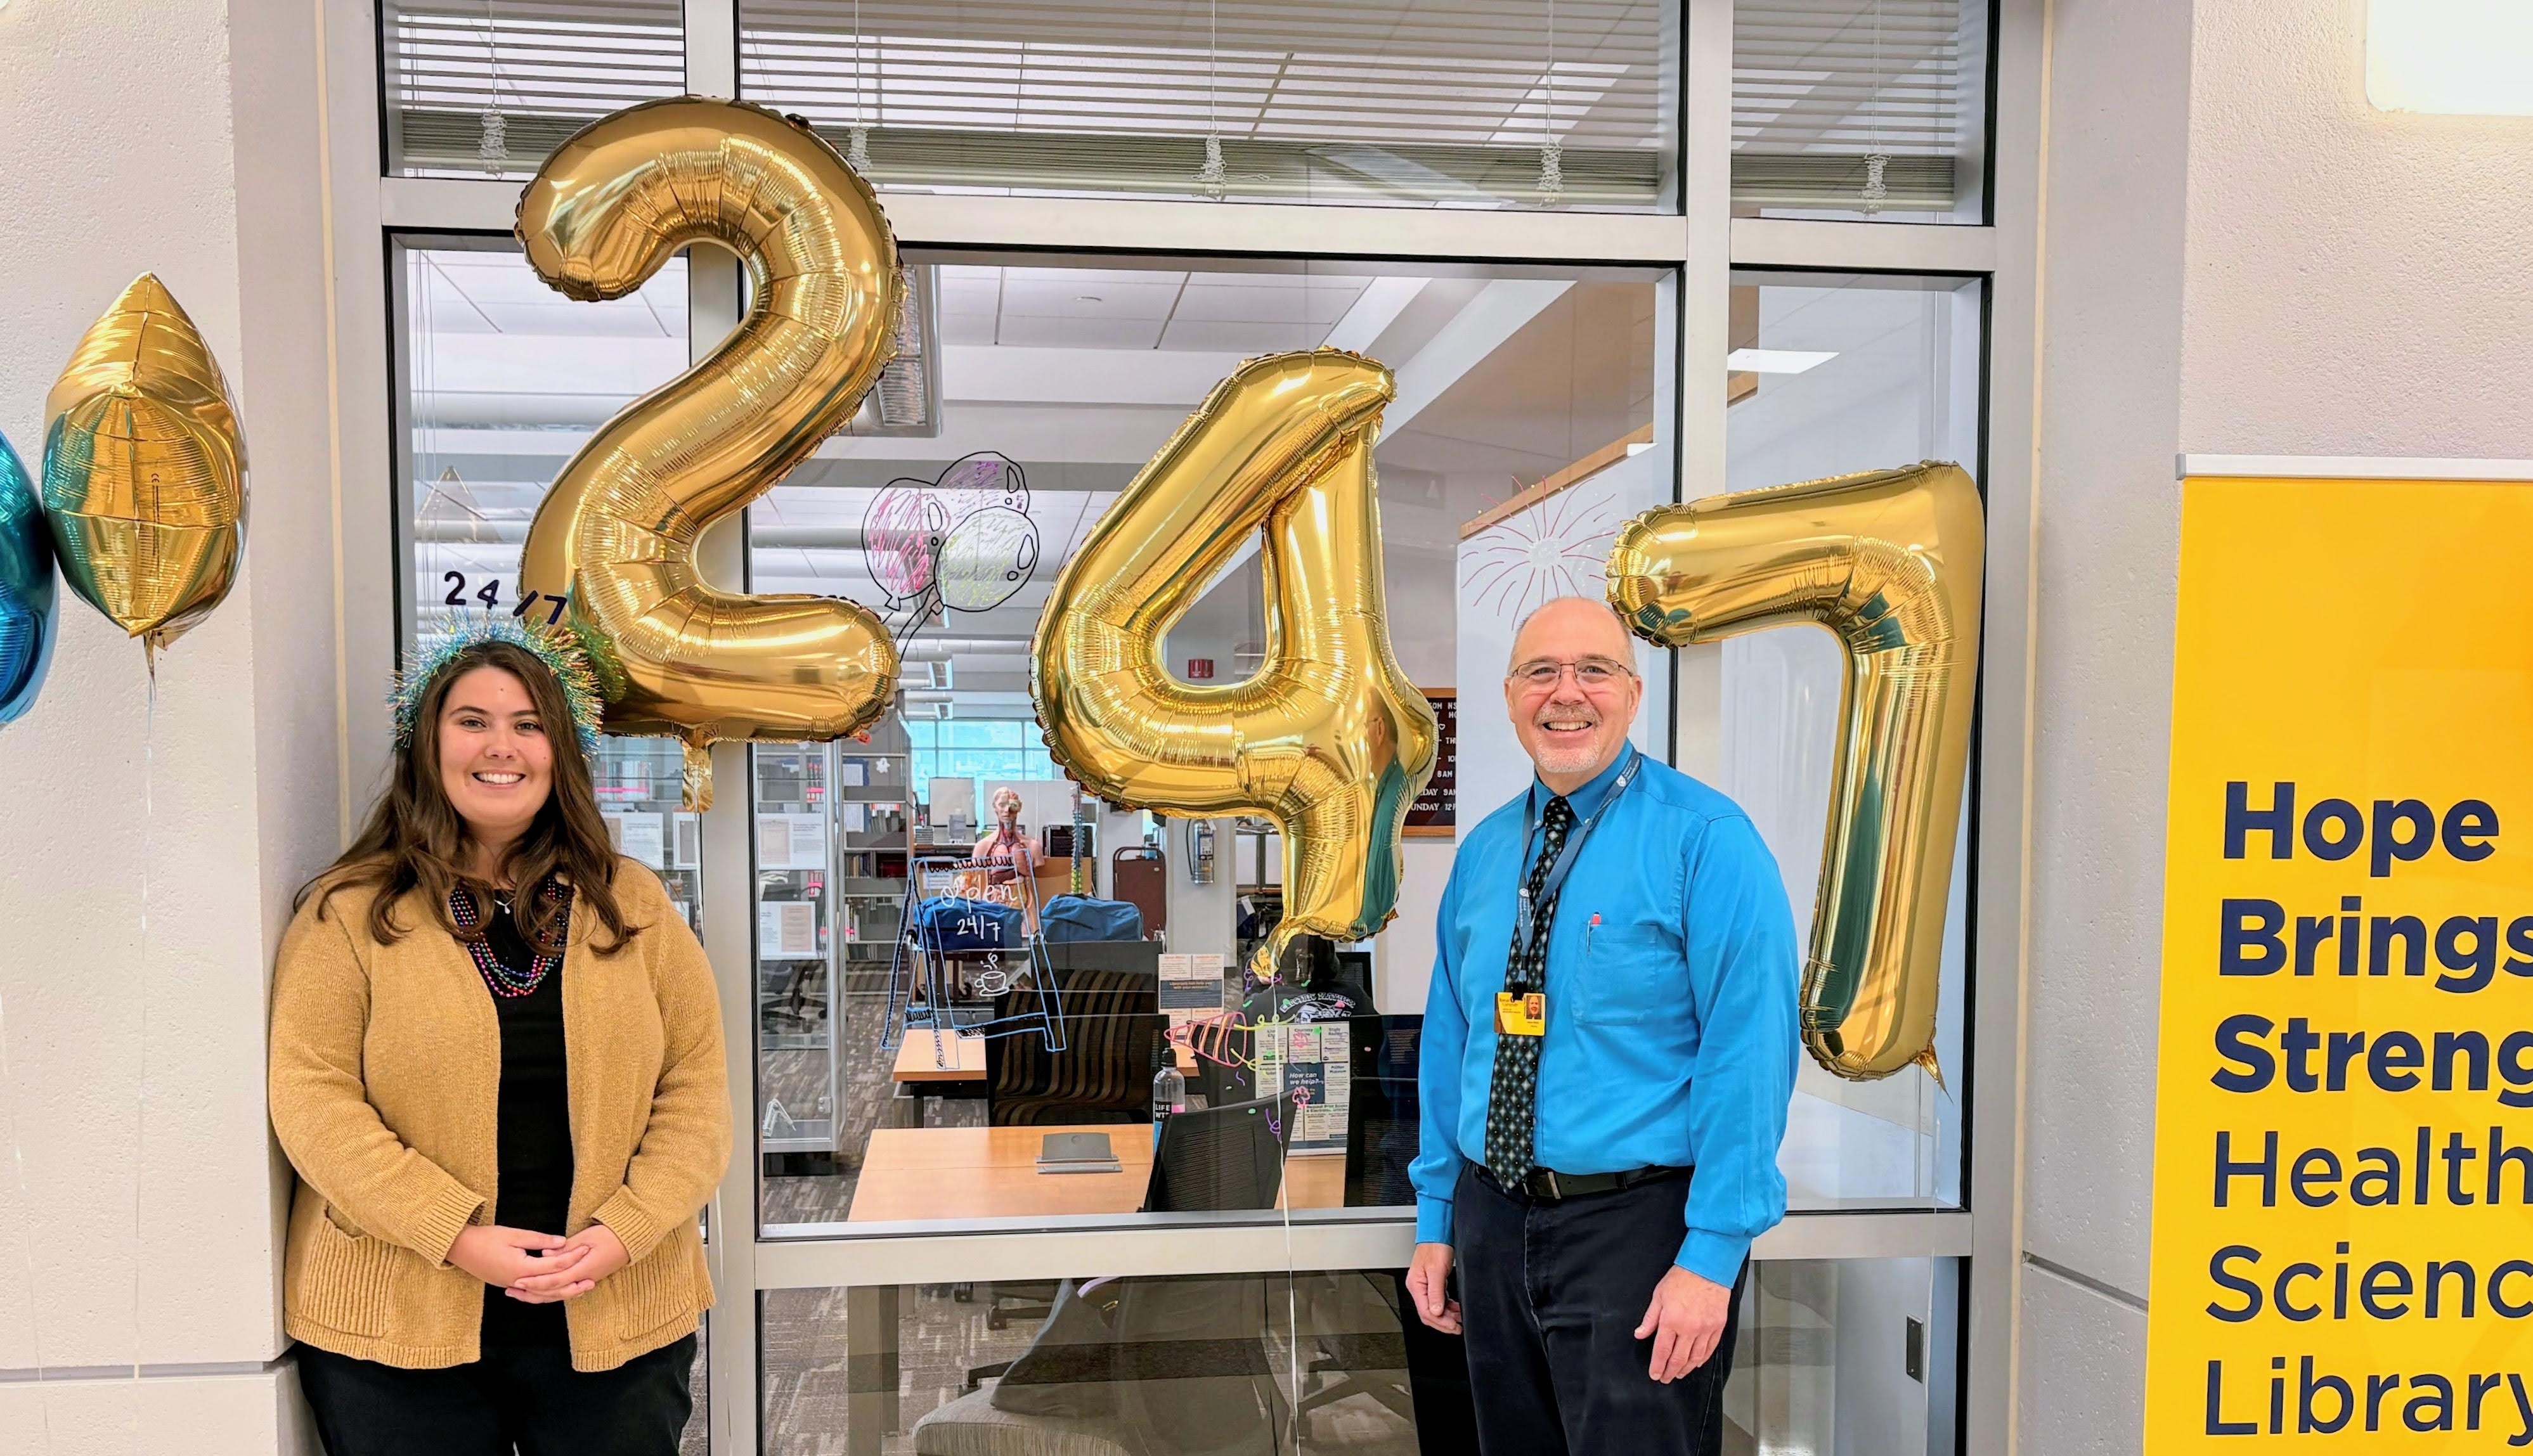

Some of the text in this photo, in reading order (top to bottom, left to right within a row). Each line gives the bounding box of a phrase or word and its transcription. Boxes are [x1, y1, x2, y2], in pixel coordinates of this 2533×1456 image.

[444, 570, 567, 625] 24/7
[515, 95, 1985, 1083] 2 4 7
[2223, 781, 2499, 877] Hope
[940, 875, 1018, 913] Open
[957, 915, 1001, 942] 24/7
[2219, 895, 2533, 993] Brings
[2210, 1014, 2533, 1108] Streng
[2213, 1126, 2533, 1208] Health
[2205, 1241, 2533, 1323] Scienc
[2205, 1355, 2533, 1447] Library
